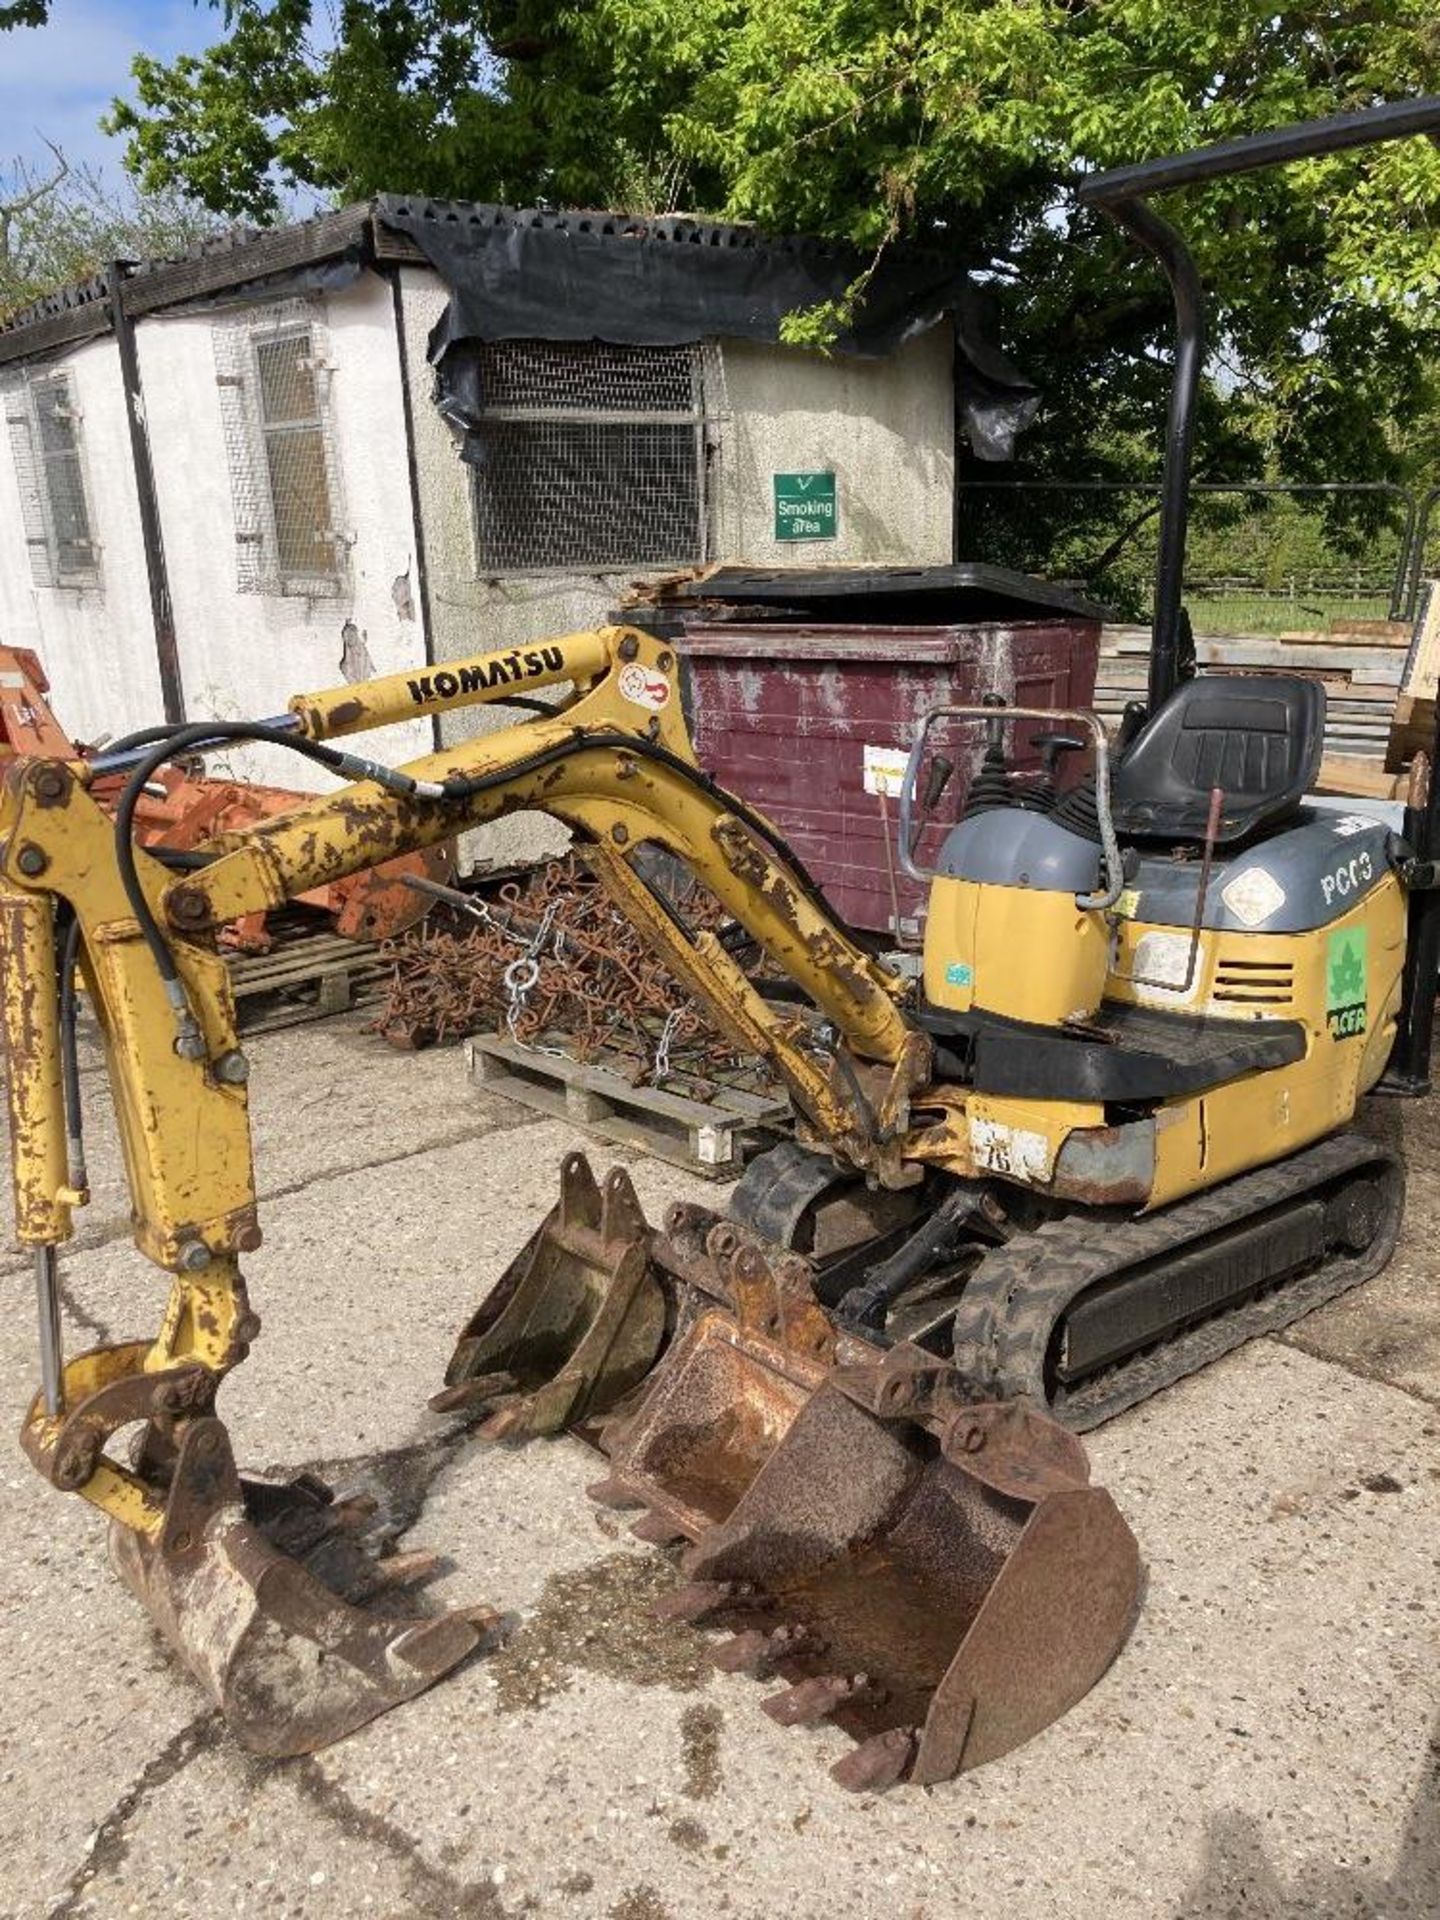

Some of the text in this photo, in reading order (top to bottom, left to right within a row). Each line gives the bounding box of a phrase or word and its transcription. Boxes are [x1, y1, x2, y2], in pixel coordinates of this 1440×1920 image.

[778, 500, 833, 517] Smoking
[792, 520, 821, 534] area
[407, 647, 564, 704] KOMATSU
